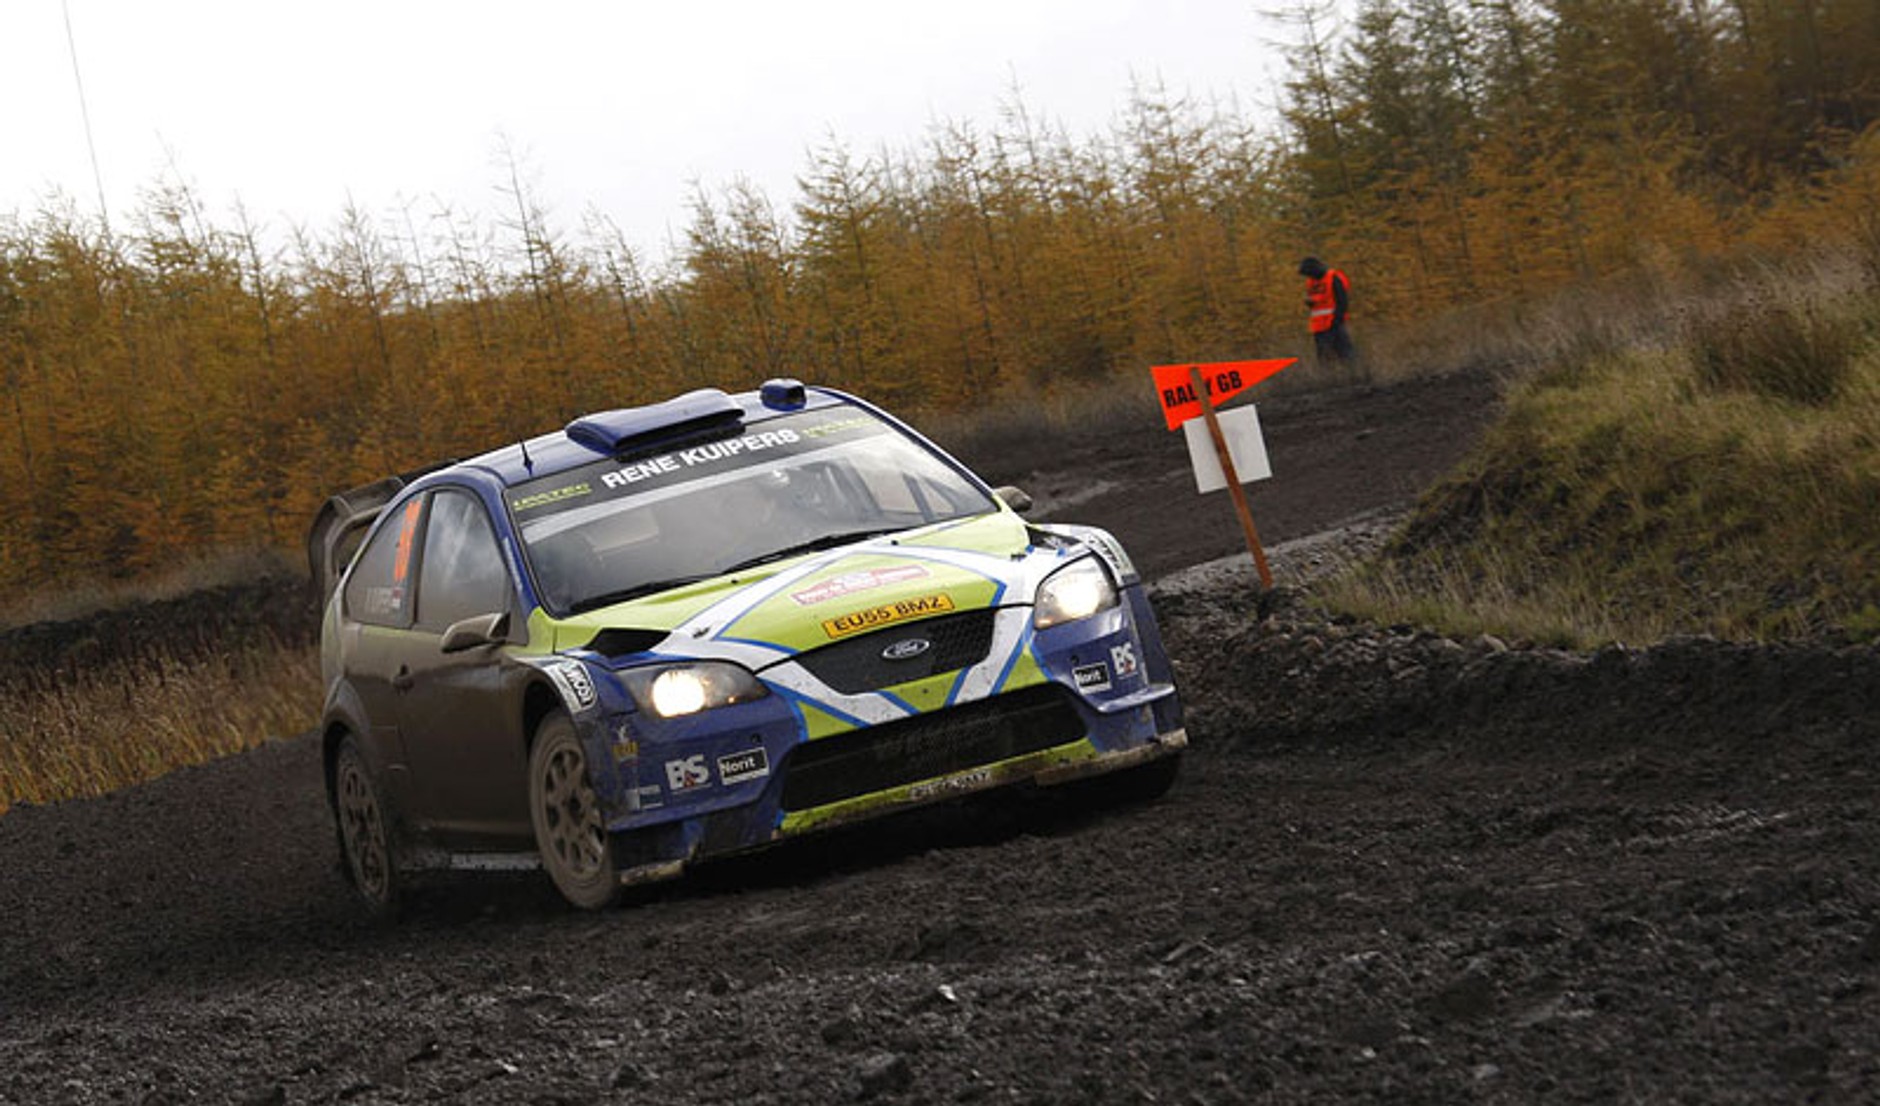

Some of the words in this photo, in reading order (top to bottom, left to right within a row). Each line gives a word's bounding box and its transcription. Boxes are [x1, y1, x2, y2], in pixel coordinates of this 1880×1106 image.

[1163, 377, 1212, 408] RALY
[1216, 370, 1242, 393] GB
[601, 455, 680, 489] RENE
[679, 429, 800, 466] KUIPERS
[833, 608, 891, 631] EU55
[895, 598, 943, 615] BMZ
[720, 757, 756, 774] Norit
